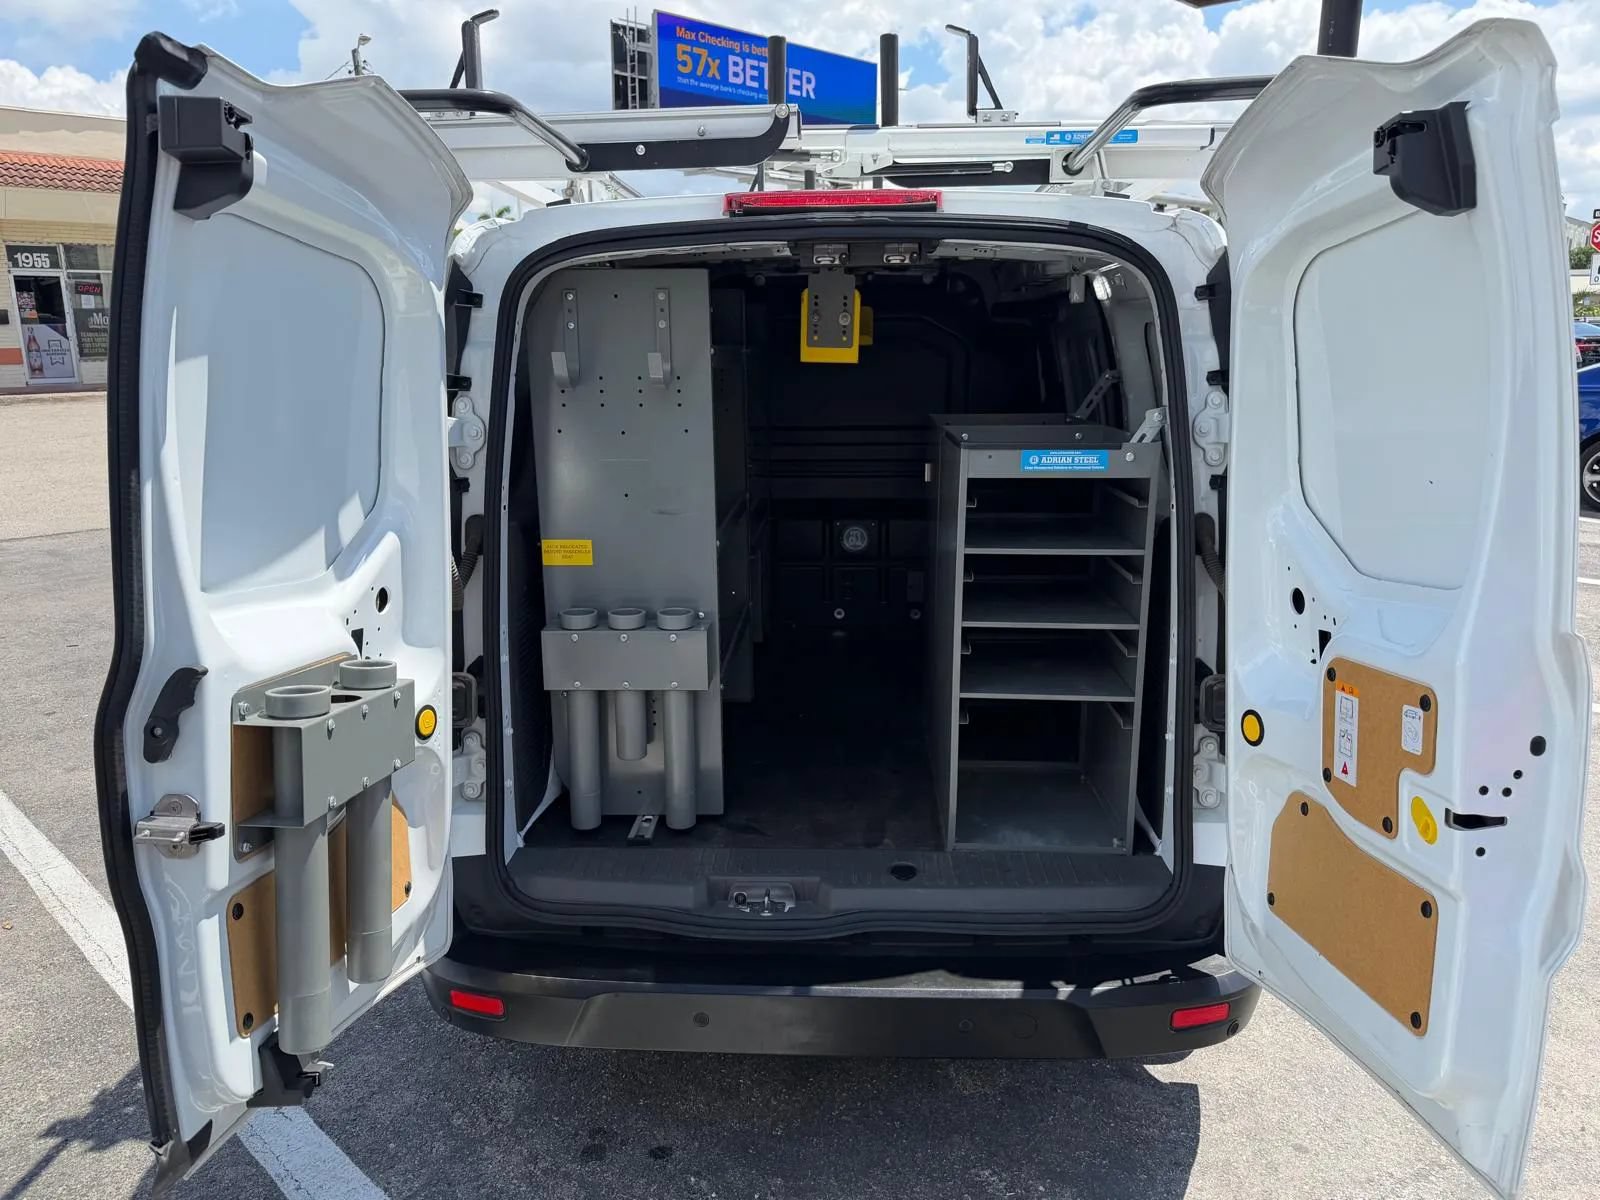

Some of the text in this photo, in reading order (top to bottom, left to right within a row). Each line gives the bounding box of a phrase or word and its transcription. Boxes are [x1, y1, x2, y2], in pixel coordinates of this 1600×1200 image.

[676, 26, 768, 57] Max Checking is bett
[676, 43, 816, 99] 57x BETER
[699, 82, 720, 91] average
[736, 89, 758, 99] checking
[14, 252, 50, 268] 1955
[78, 285, 101, 293] OPEN
[93, 312, 109, 325] Mo
[1040, 456, 1099, 464] ADRIAN STEEL
